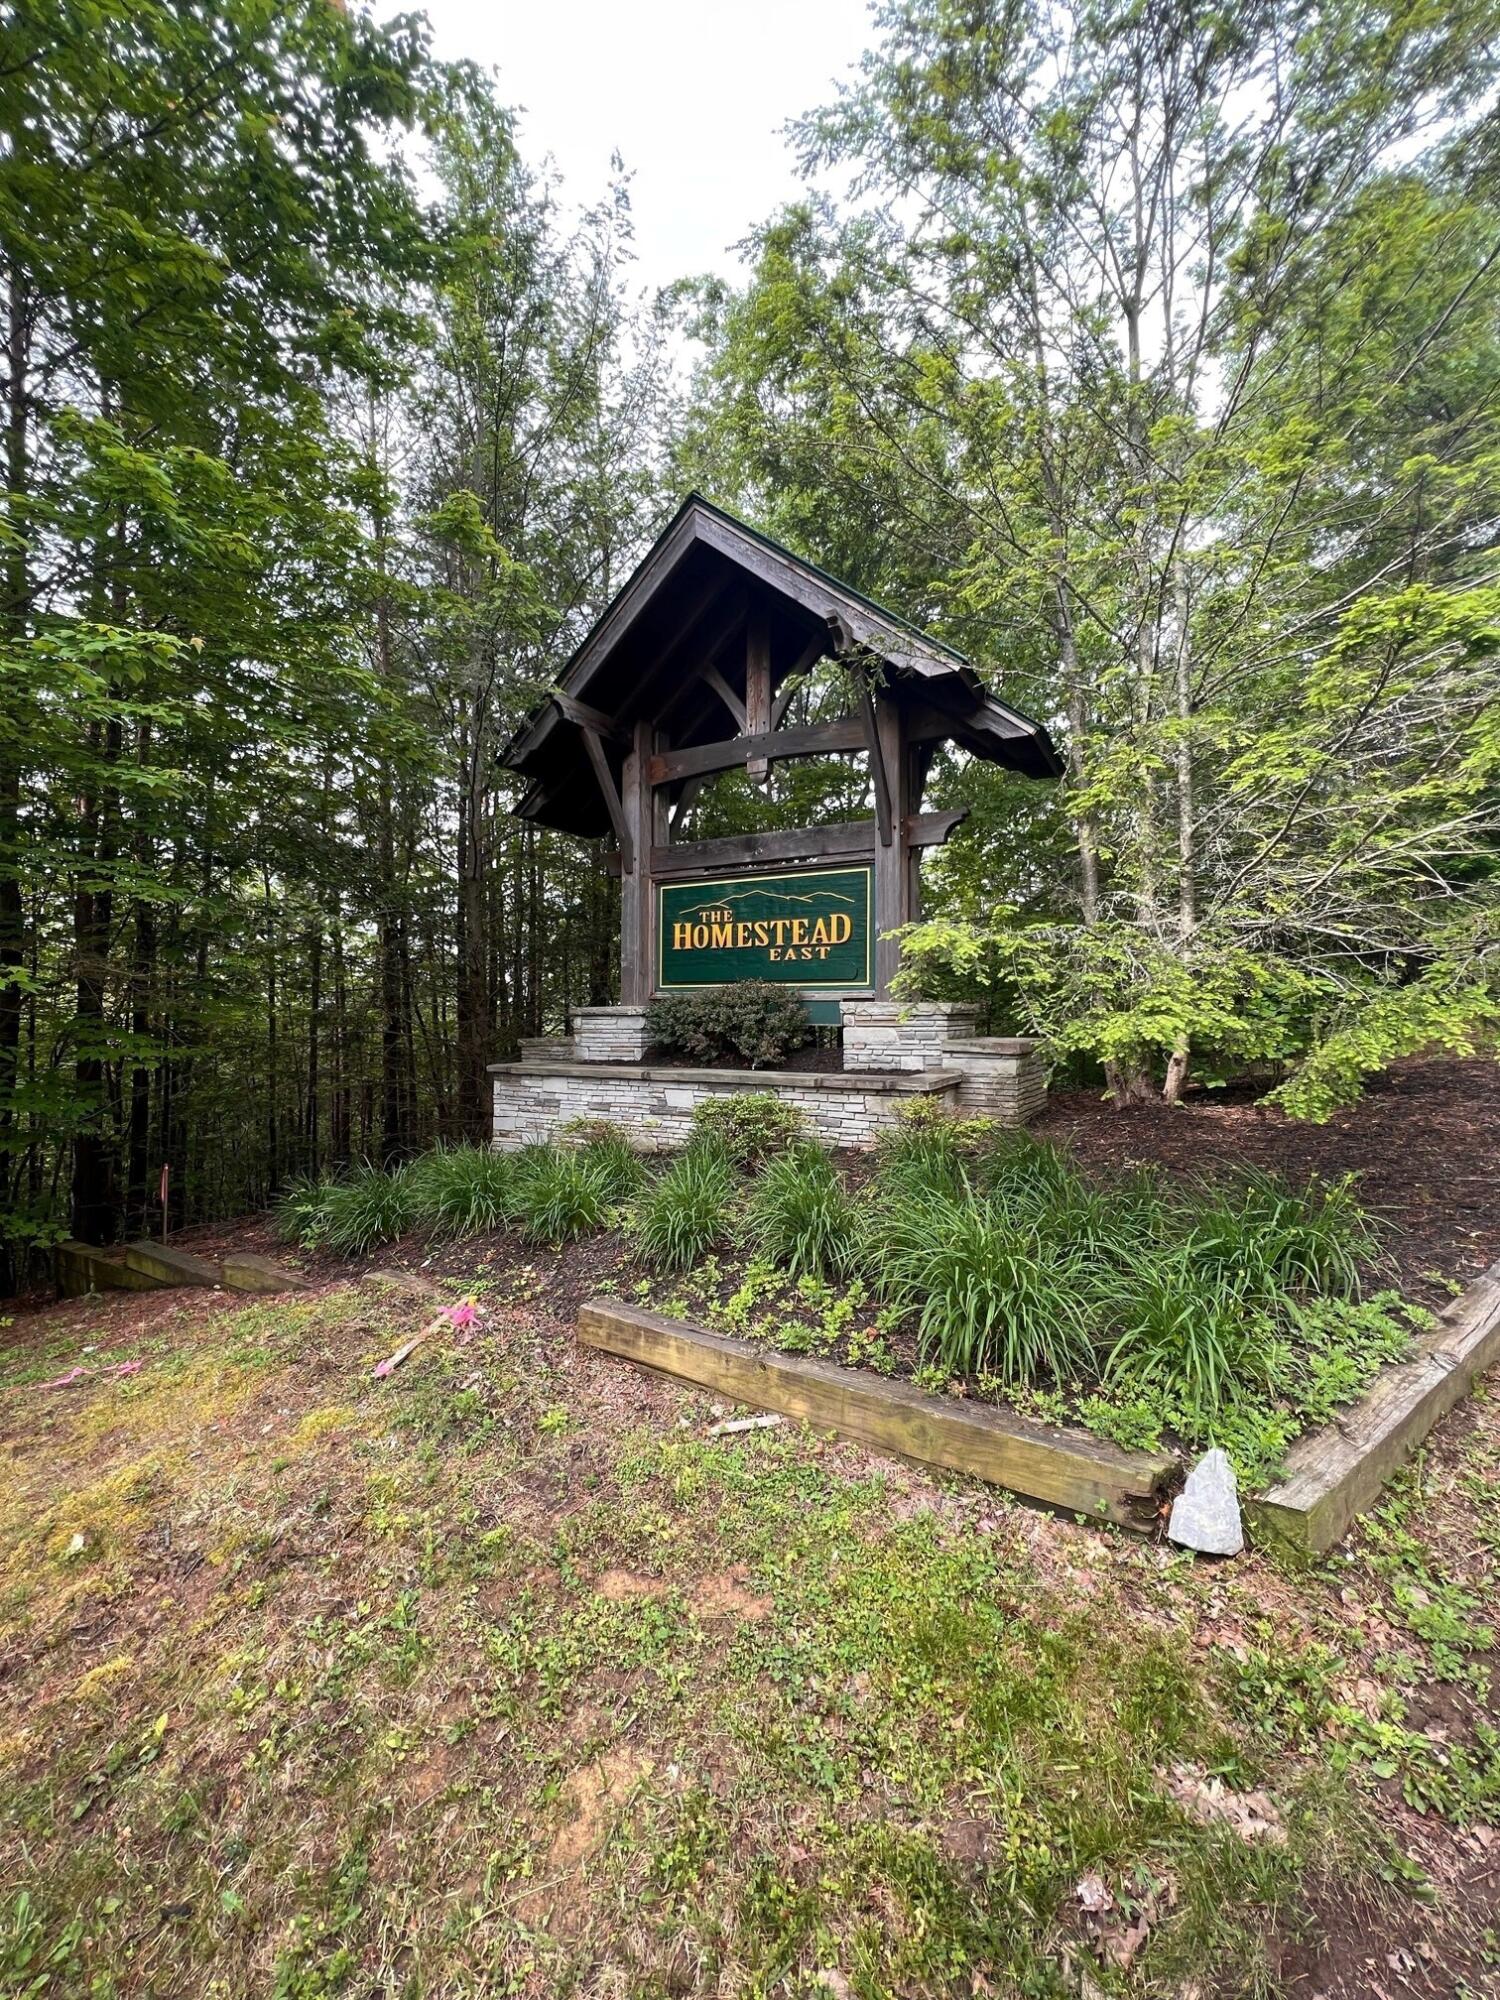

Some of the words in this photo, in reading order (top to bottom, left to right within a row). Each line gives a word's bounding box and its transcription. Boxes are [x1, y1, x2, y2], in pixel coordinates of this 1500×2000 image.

[699, 910, 733, 923] THE
[672, 913, 852, 950] HOMESTEAD
[769, 946, 831, 961] EAST
